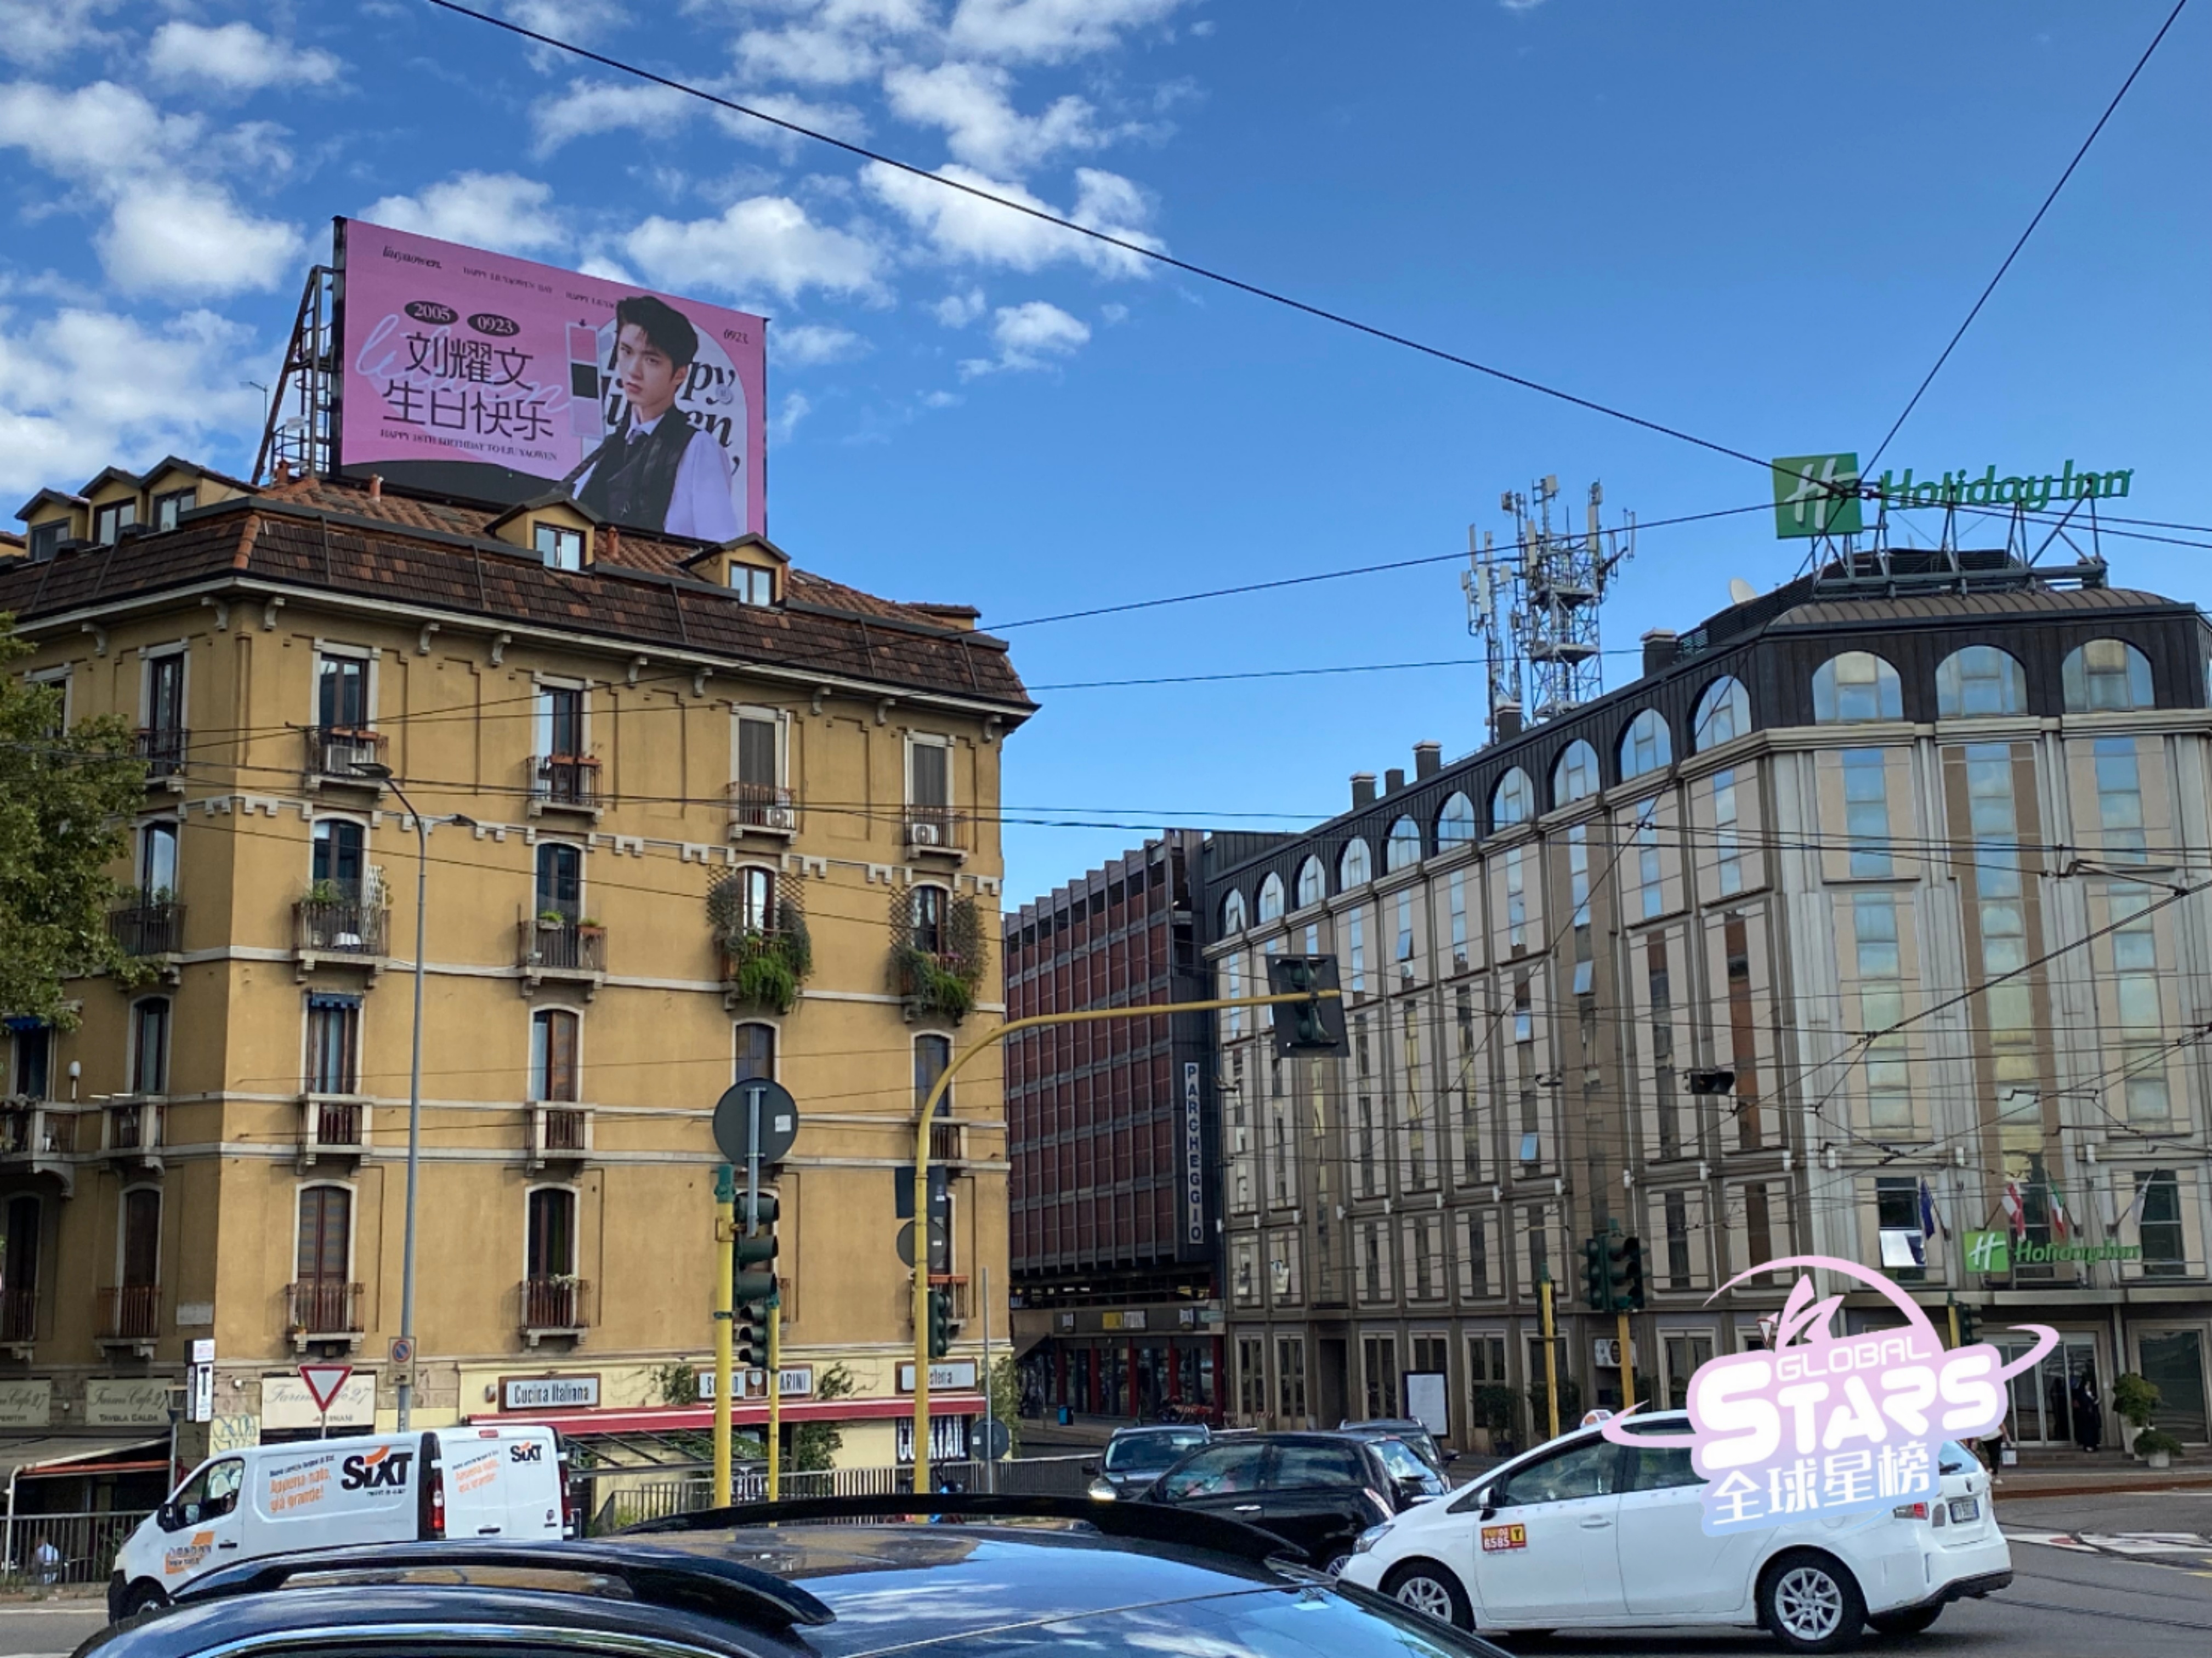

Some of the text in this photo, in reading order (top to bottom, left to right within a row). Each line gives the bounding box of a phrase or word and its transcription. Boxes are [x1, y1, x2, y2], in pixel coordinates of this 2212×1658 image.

[413, 303, 451, 321] 2005
[477, 316, 514, 334] 0923
[405, 331, 534, 391] 刘耀文
[382, 379, 554, 441] 生日快乐
[1880, 459, 2134, 512] Holiday Inn
[1187, 1066, 1201, 1240] PARCHEGGIO
[514, 1384, 548, 1404] Cucina
[779, 1372, 806, 1391] ARINI
